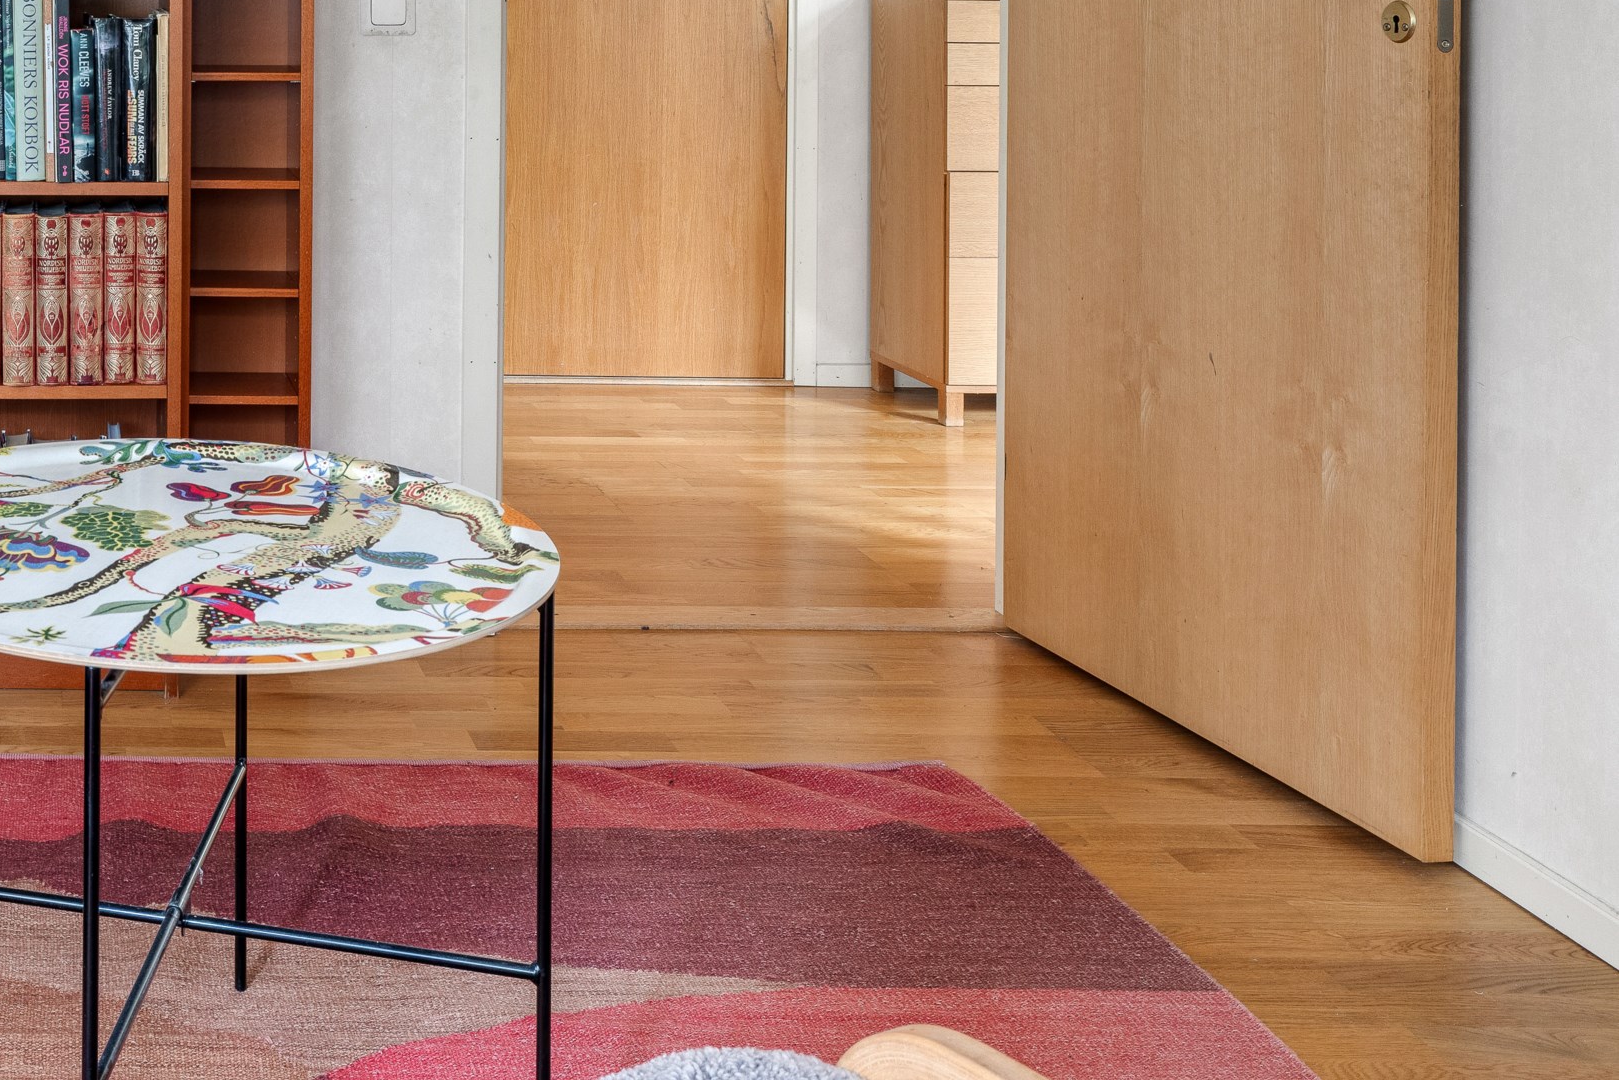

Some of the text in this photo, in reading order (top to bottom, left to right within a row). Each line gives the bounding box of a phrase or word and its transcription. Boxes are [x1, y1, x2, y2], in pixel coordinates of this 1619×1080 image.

[78, 33, 90, 88] ANN CLEEVES
[131, 24, 143, 82] Tom Clancy
[24, 96, 39, 173] KOKBOK
[57, 43, 70, 155] WOK RIS NUDLAR
[137, 89, 147, 164] SUMMAN AV SKRÄCK
